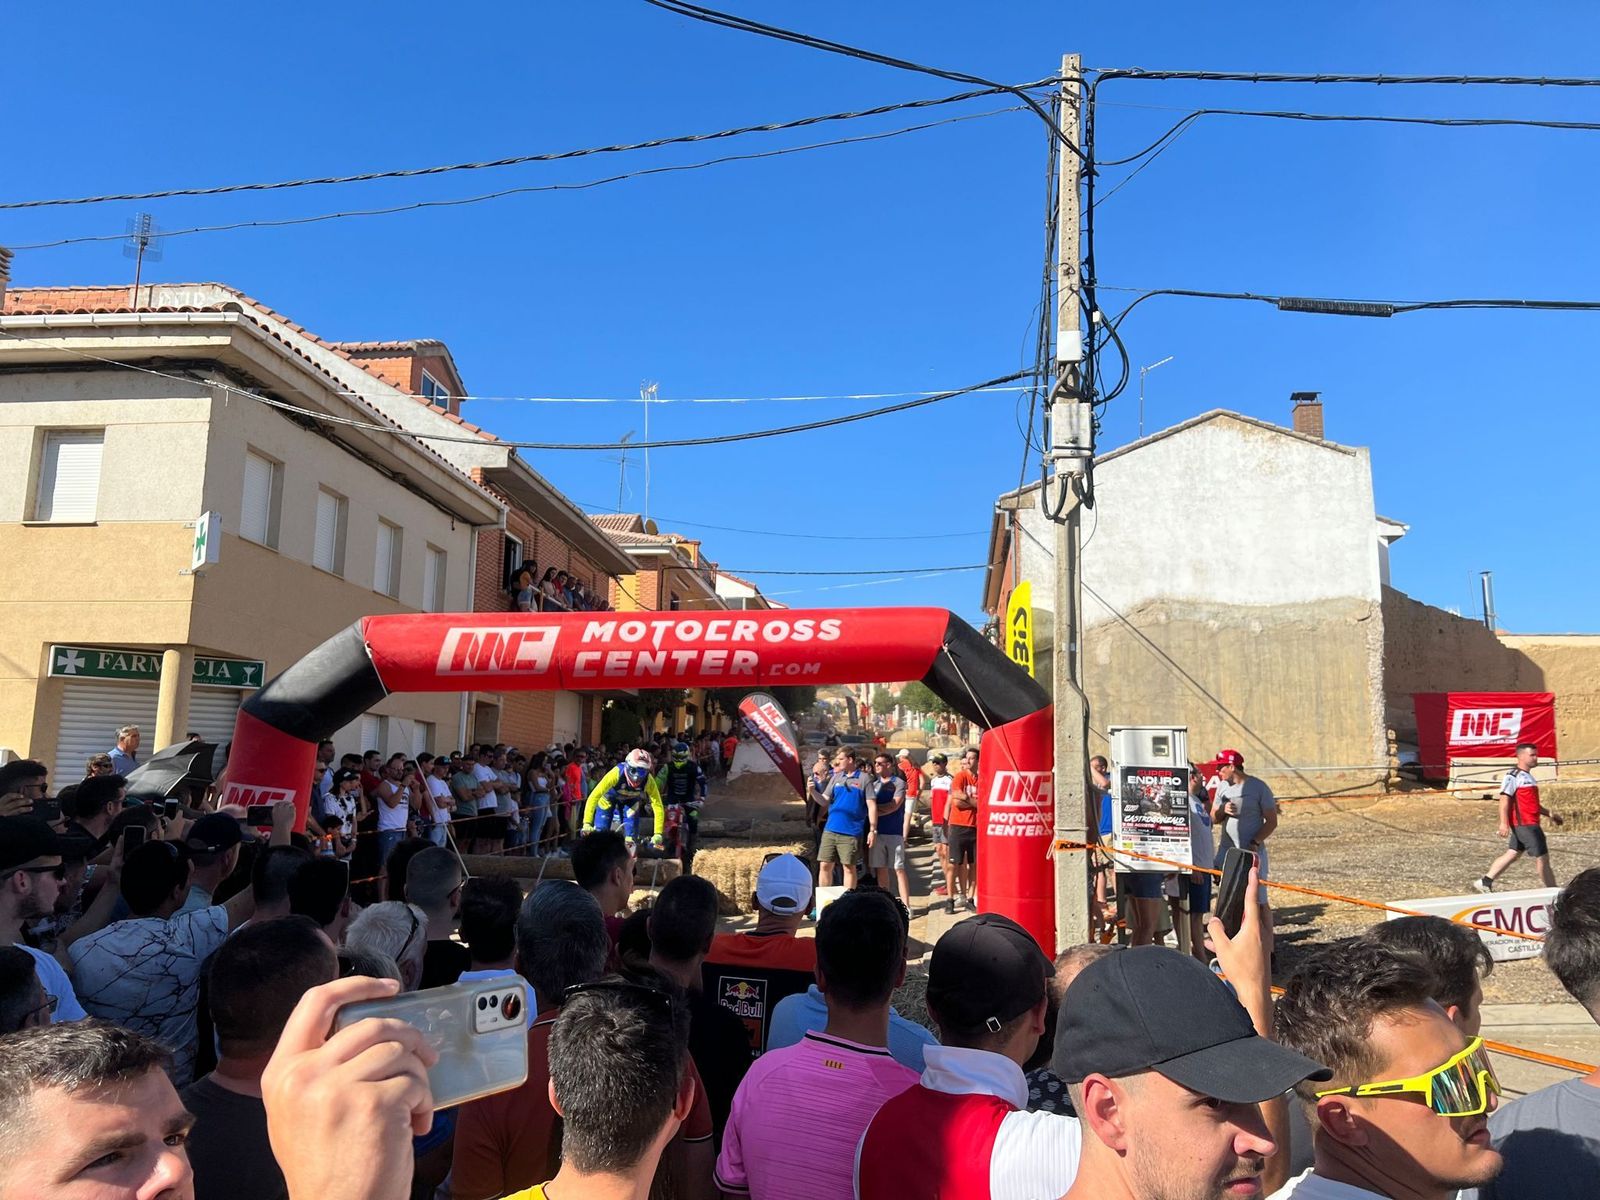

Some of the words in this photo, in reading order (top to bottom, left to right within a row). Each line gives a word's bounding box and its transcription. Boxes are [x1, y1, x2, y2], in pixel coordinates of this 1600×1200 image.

[581, 618, 842, 650] MOTOCROSS
[97, 652, 231, 678] FARMCIA
[1127, 775, 1182, 786] ENDURO
[989, 812, 1053, 825] MOTOCROS
[987, 824, 1052, 837] CENTER
[741, 1001, 763, 1018] Bull
